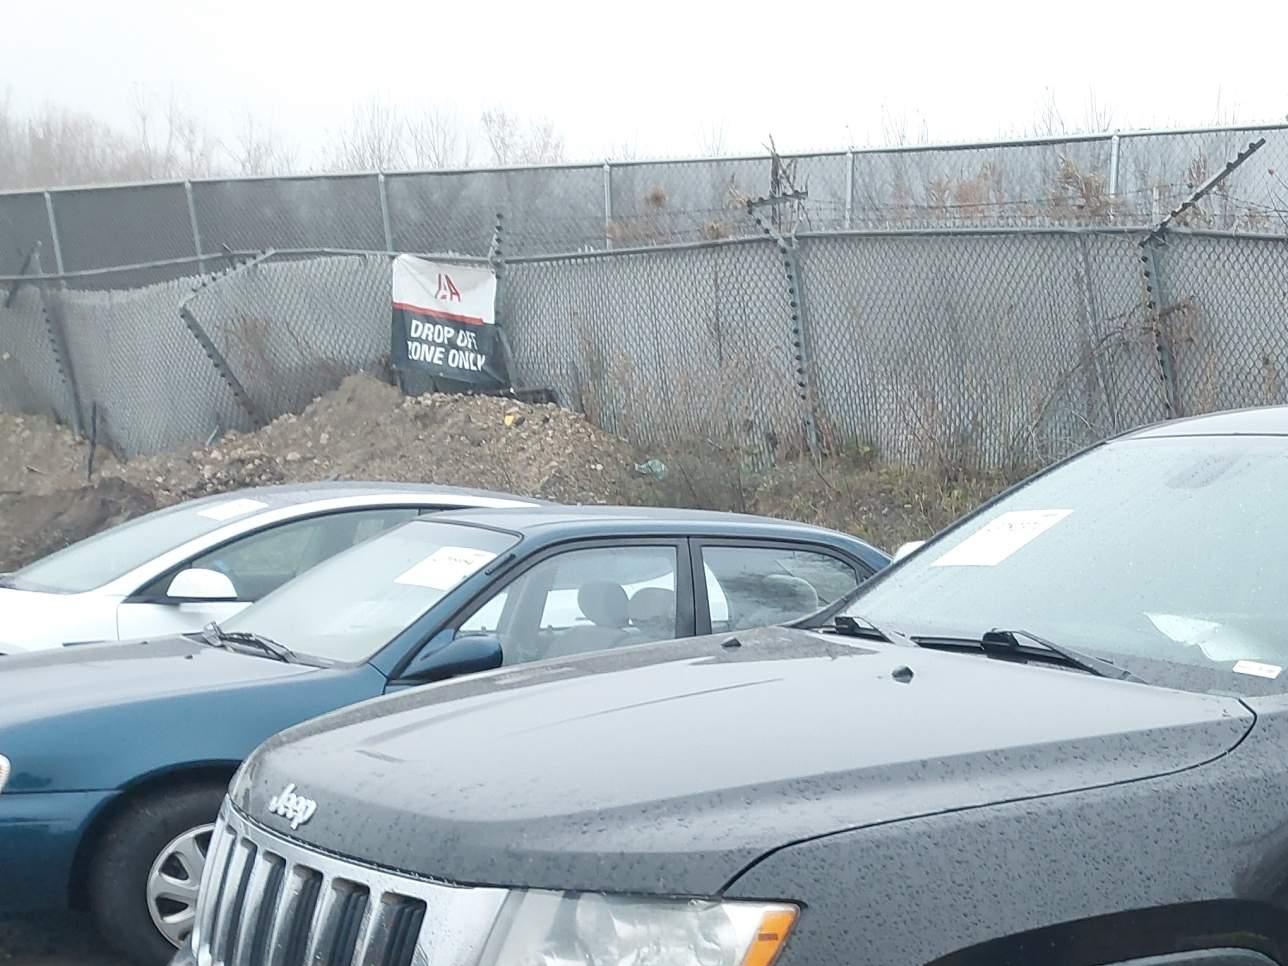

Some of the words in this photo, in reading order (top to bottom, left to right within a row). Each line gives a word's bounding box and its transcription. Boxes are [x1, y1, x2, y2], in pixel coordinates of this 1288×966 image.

[410, 319, 455, 345] DROP
[448, 348, 486, 371] ONLY
[268, 783, 317, 831] Jeep
